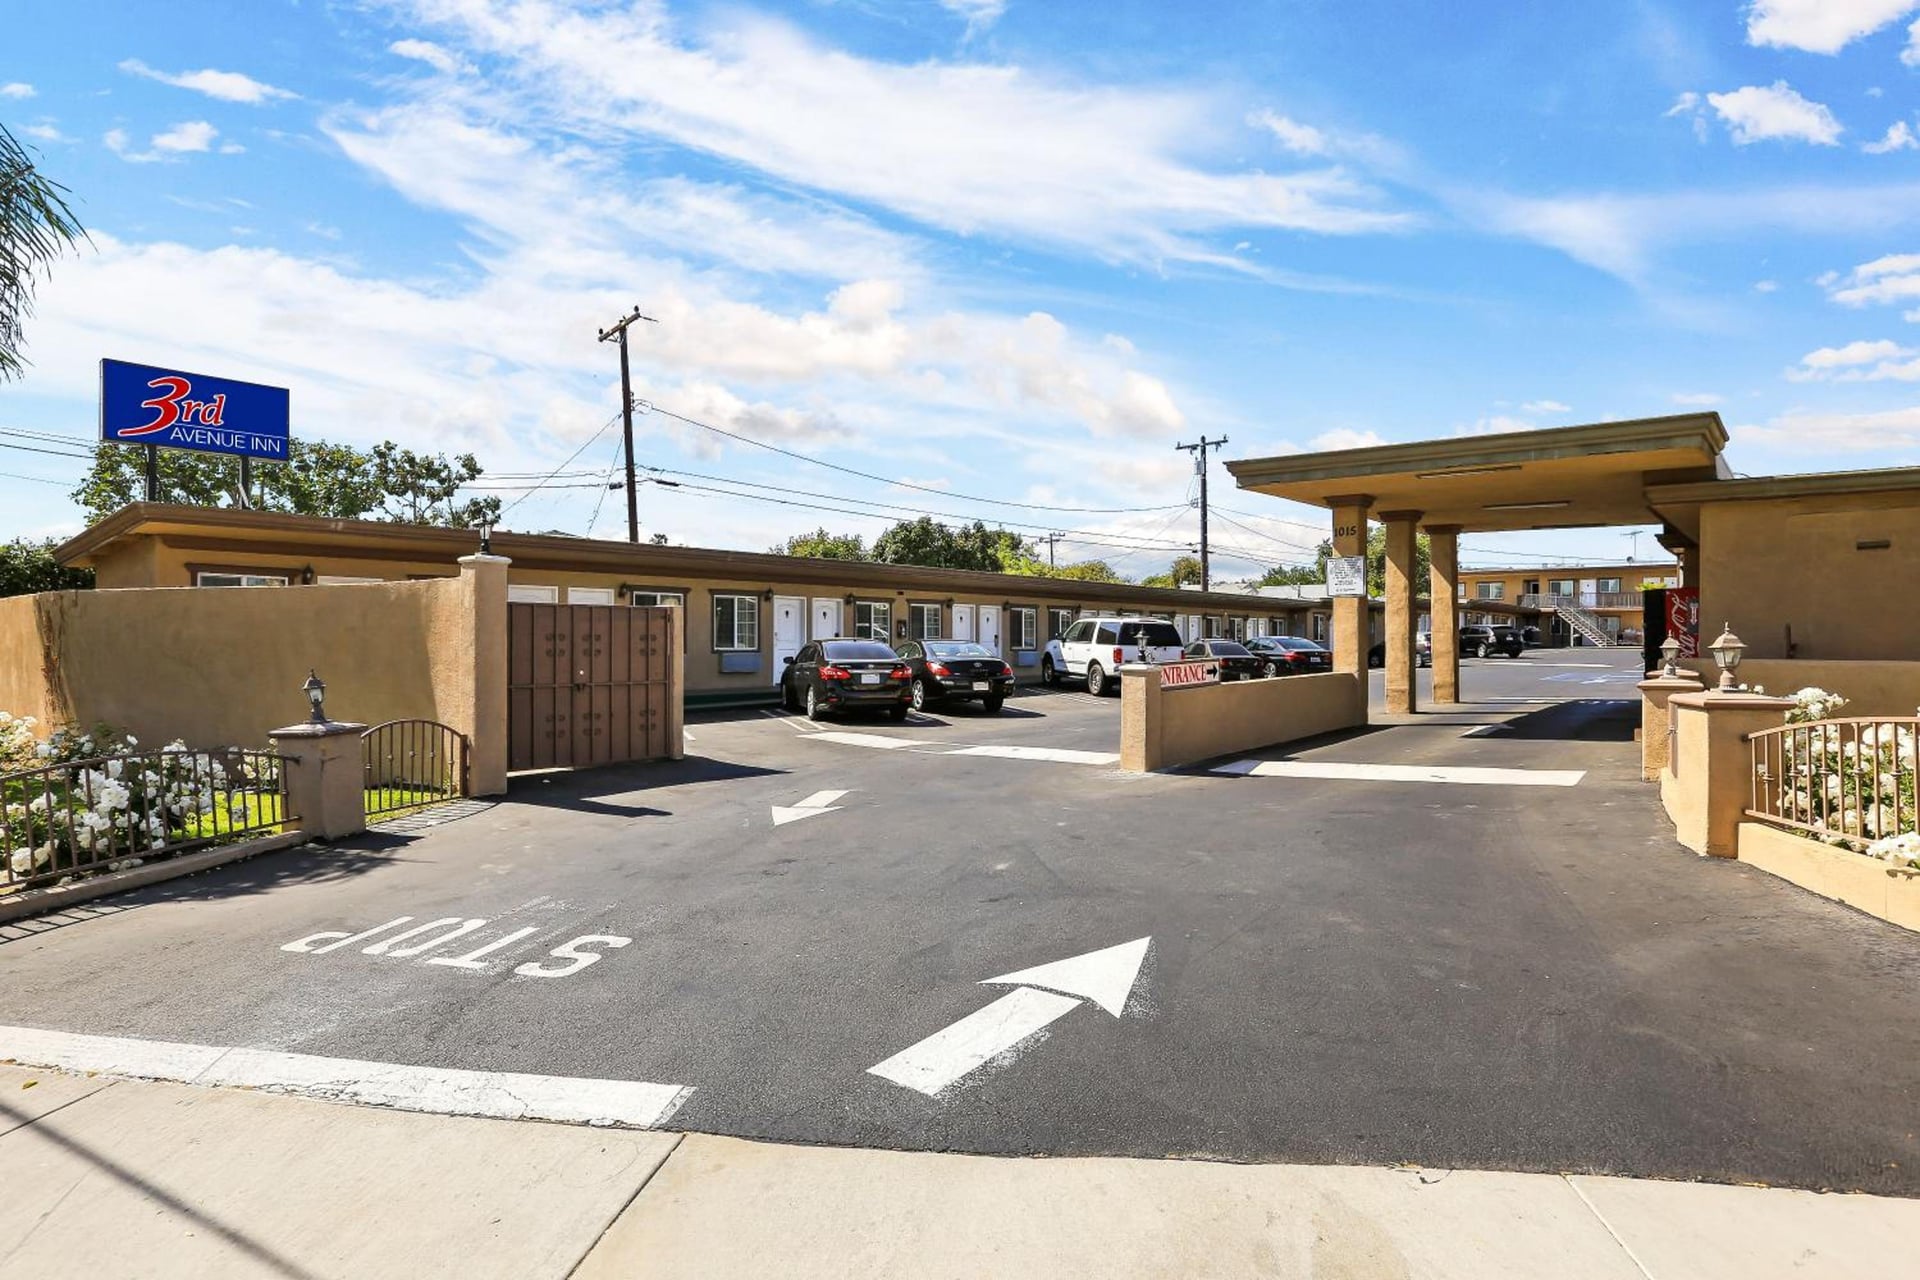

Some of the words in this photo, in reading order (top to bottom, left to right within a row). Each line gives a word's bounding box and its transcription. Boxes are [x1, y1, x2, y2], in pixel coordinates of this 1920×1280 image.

[118, 375, 226, 437] 3rd
[170, 427, 246, 449] AVENUE
[251, 437, 281, 453] INN
[1334, 525, 1357, 537] 1015
[1161, 664, 1206, 685] NTRANCE
[280, 915, 633, 978] STOP
